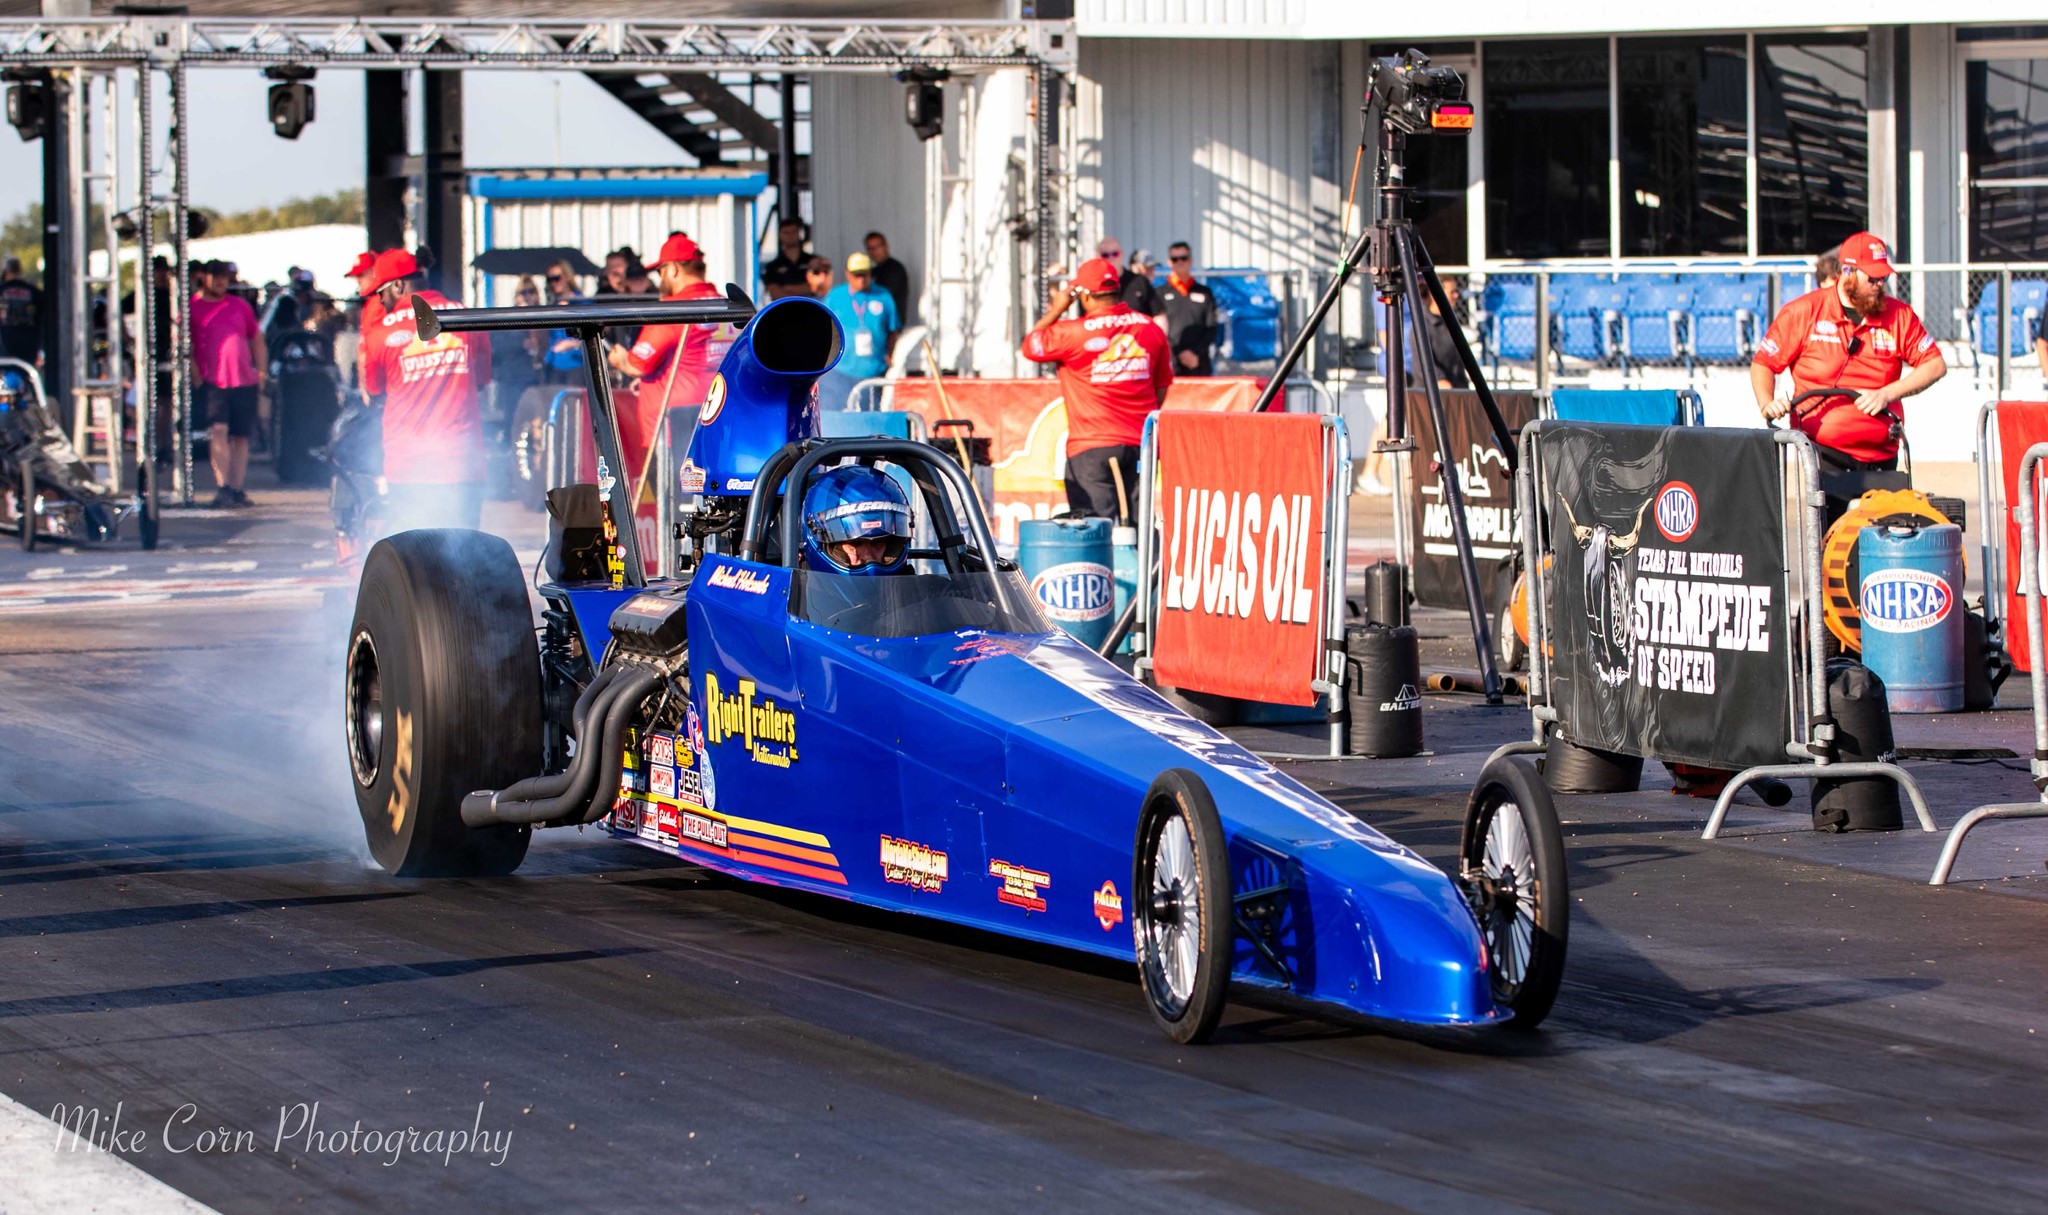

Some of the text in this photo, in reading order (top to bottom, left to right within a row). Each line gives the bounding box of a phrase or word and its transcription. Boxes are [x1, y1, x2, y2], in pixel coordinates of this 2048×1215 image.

[1660, 492, 1693, 532] NHRA
[1166, 486, 1313, 626] LUCAS OIL
[1638, 547, 1743, 578] TEXAS FALL NATIONALS
[1045, 574, 1110, 610] NHRA
[1867, 581, 1940, 619] NHRA
[1635, 577, 1771, 652] STAMPEDE
[1637, 644, 1716, 695] OF SPEED
[706, 672, 744, 744] Right
[738, 678, 796, 750] Trailers
[680, 769, 702, 797] JESEL
[684, 816, 697, 834] THE
